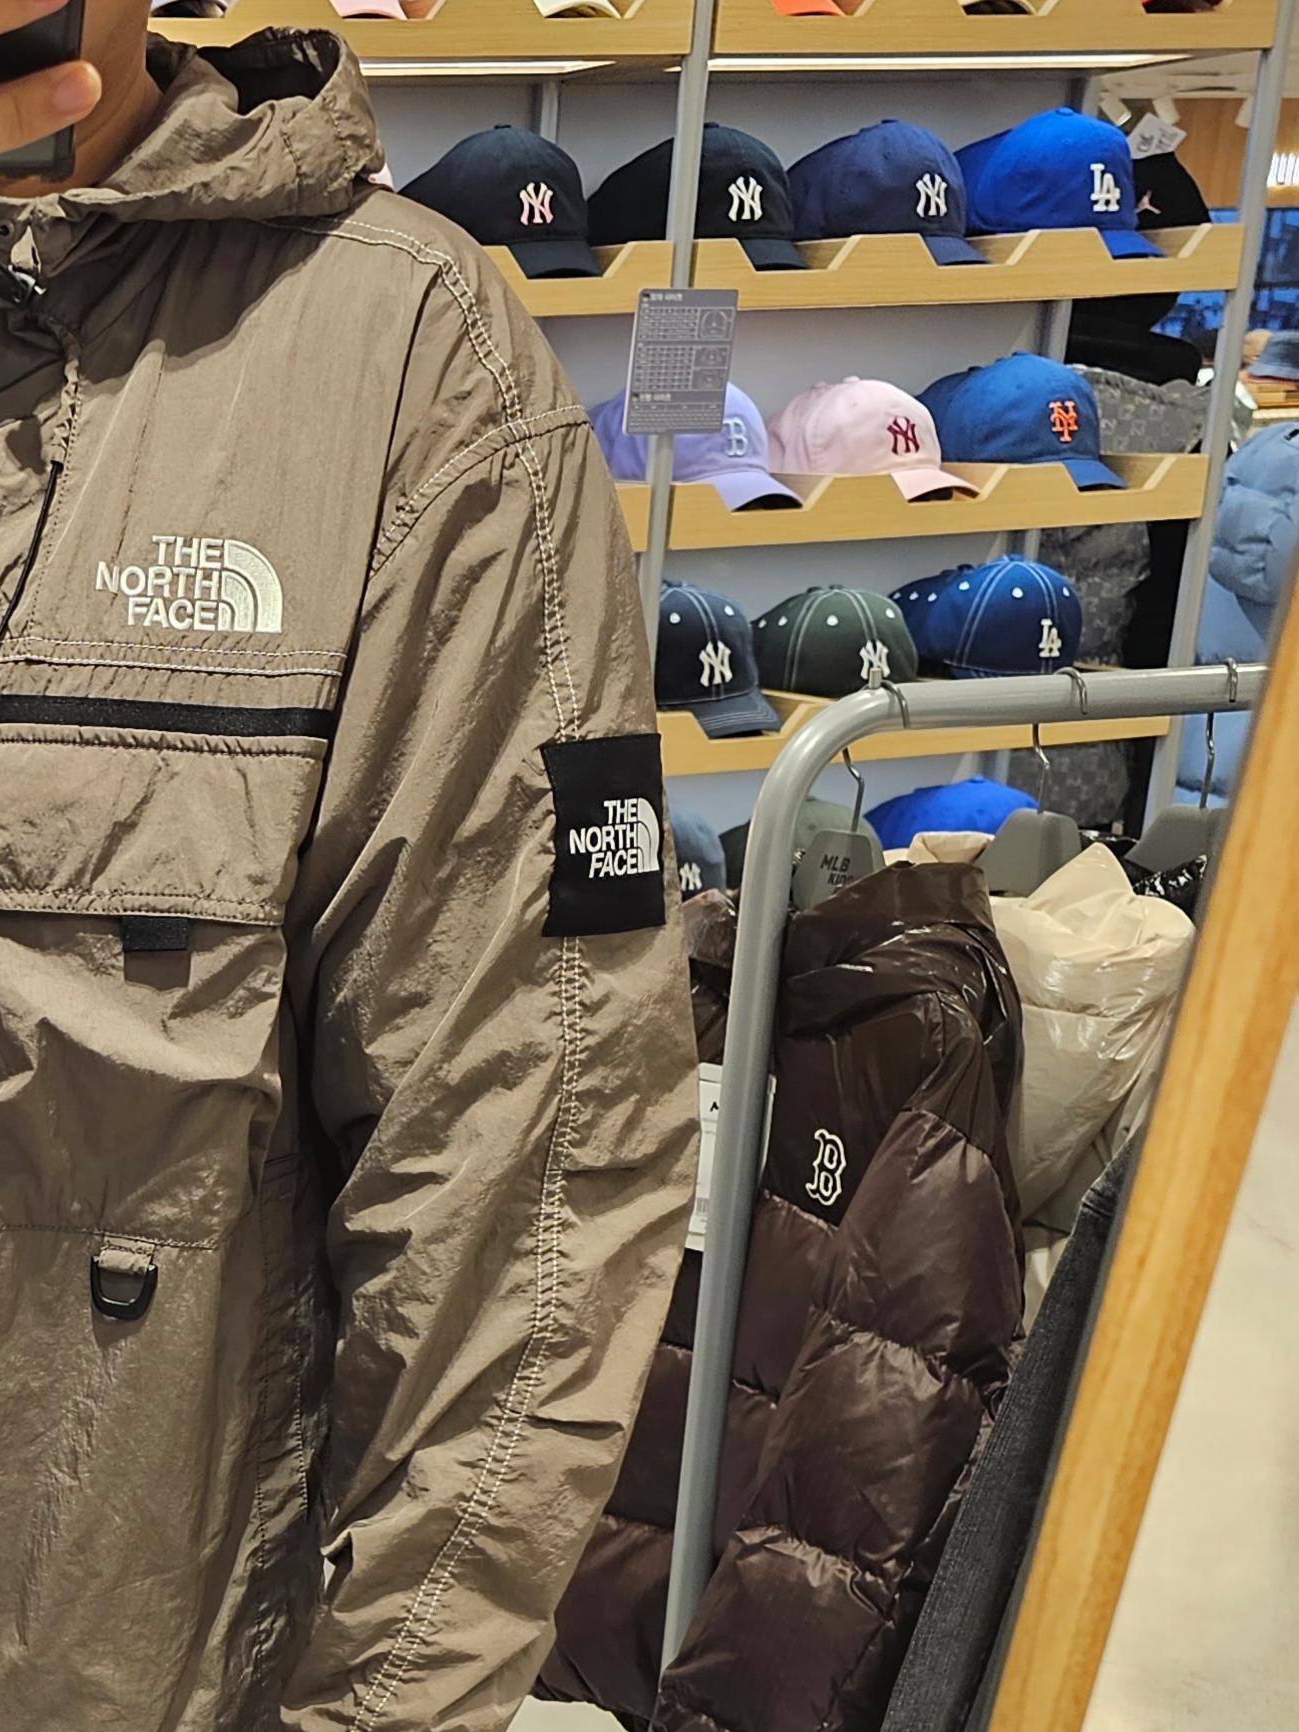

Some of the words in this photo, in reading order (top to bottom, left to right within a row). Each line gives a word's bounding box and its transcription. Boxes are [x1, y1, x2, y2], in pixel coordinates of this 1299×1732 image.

[519, 182, 553, 226] NY
[727, 175, 763, 222] NY
[915, 173, 948, 218] NY
[1089, 163, 1121, 212] LA
[722, 417, 749, 457] B
[887, 416, 920, 456] NY
[152, 535, 223, 570] THE
[95, 561, 220, 600] NORTH
[127, 597, 217, 631] FACE
[1038, 618, 1062, 658] LA
[699, 640, 733, 688] NY
[859, 640, 890, 681] NY
[603, 798, 638, 825] THE
[569, 823, 638, 854] NORTH
[588, 848, 638, 879] FACE
[680, 862, 703, 891] NY
[820, 854, 851, 872] MLB
[805, 1128, 847, 1206] B
